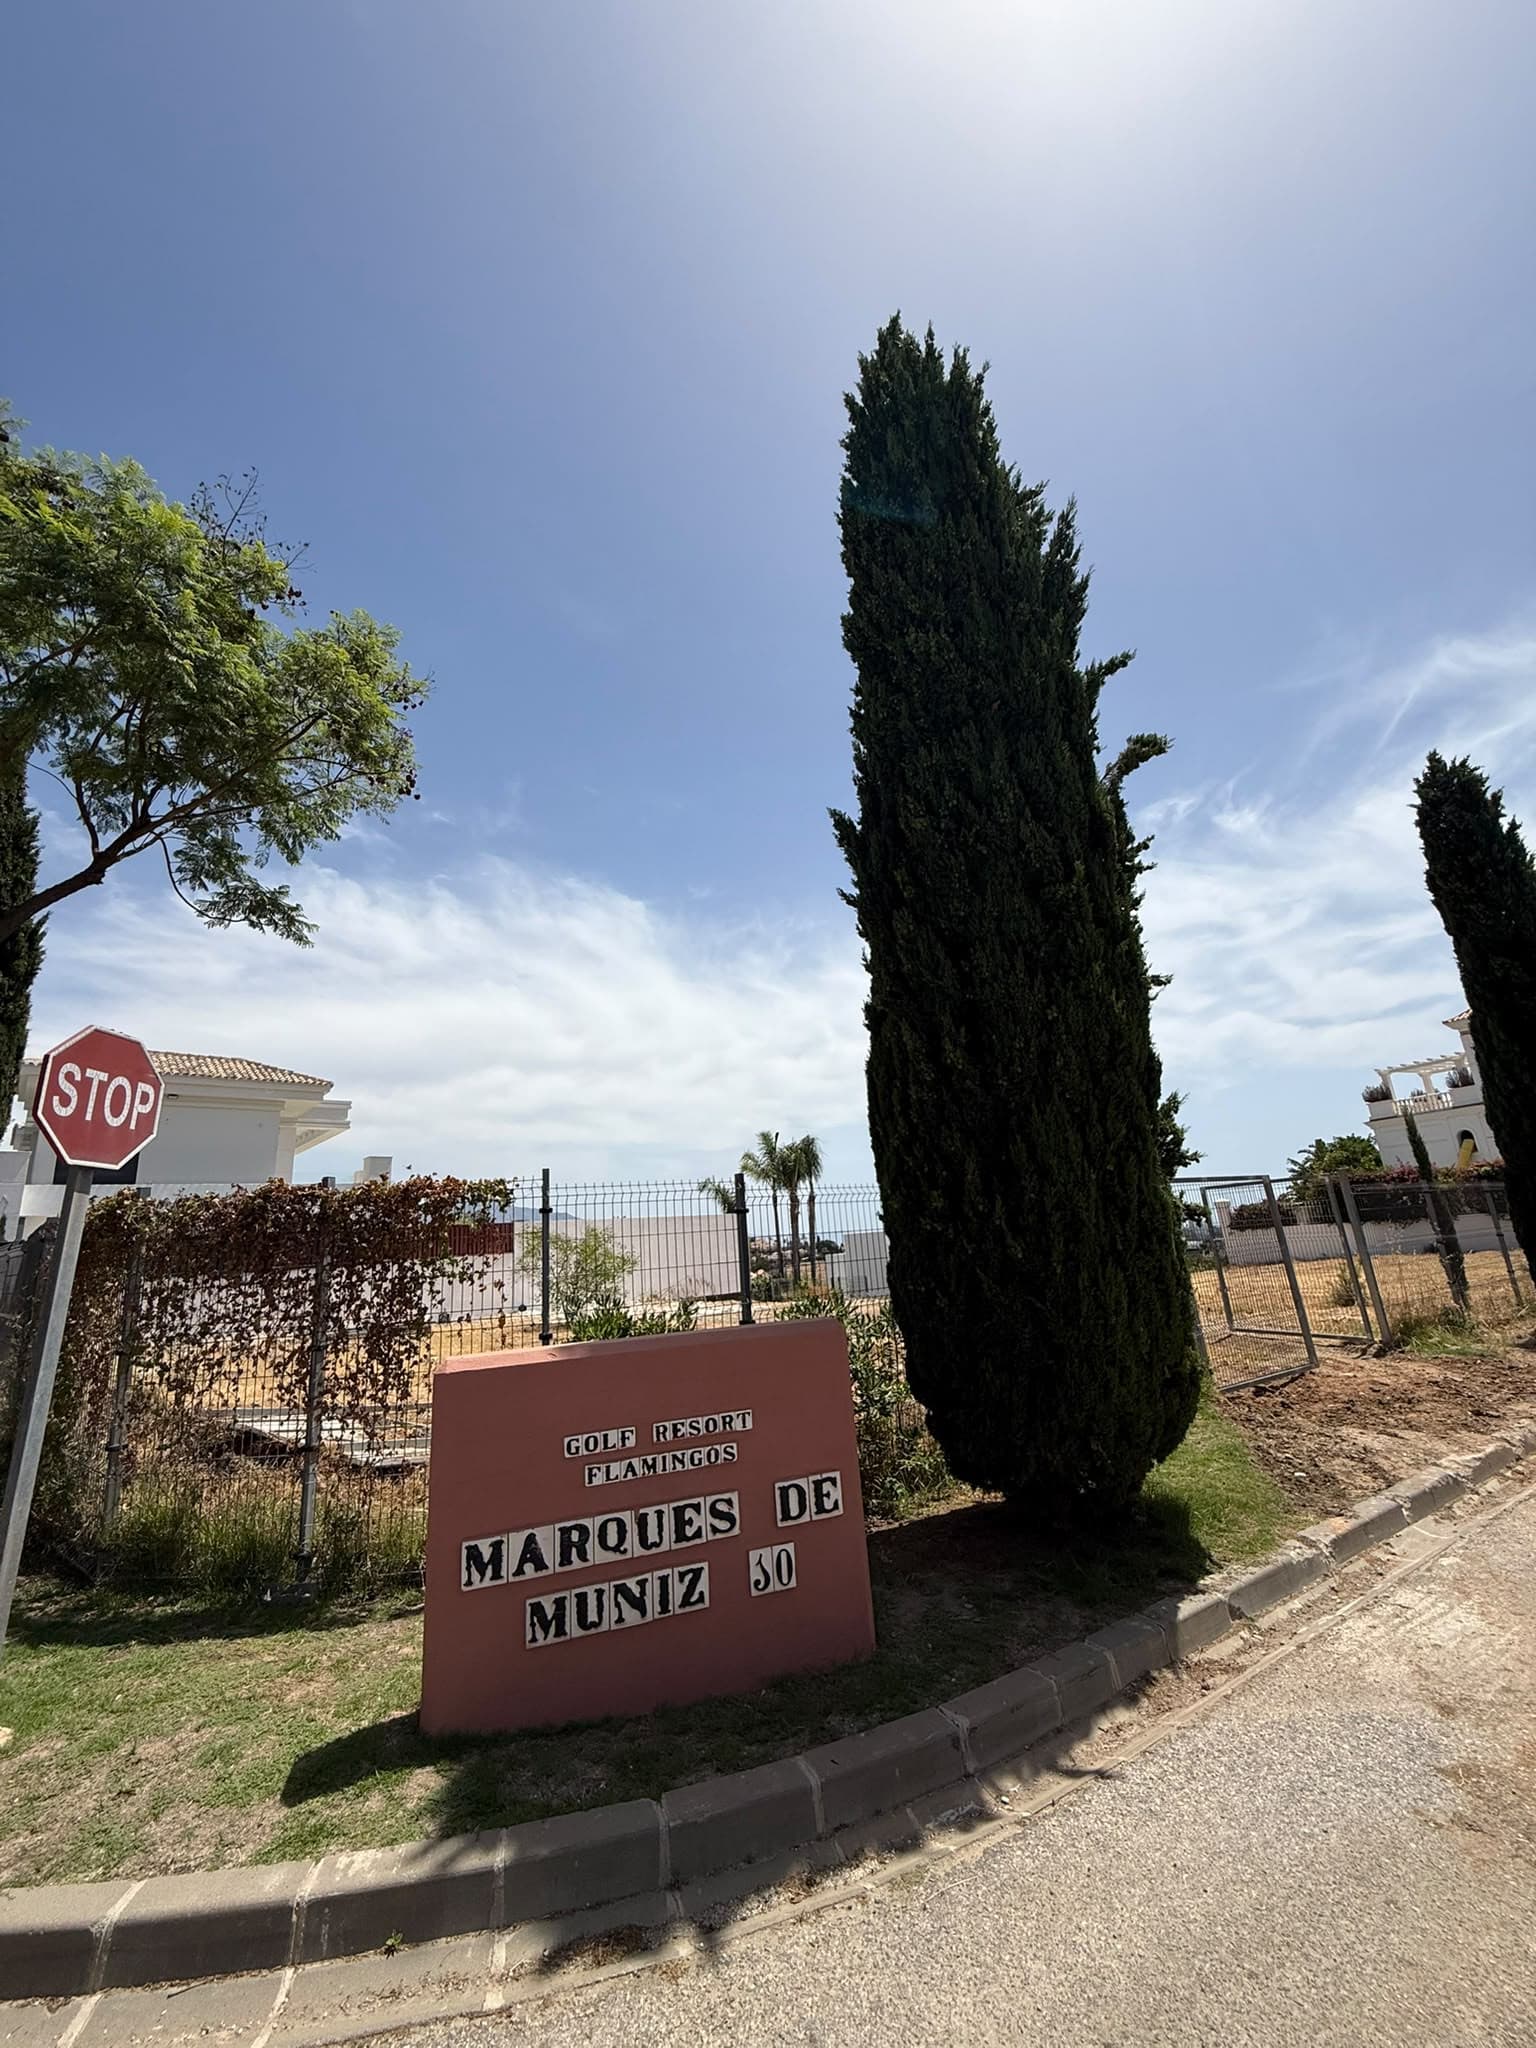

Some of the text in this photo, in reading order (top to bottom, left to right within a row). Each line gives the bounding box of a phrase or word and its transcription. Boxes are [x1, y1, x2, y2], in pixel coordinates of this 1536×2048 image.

[53, 1062, 155, 1130] STOP
[566, 1411, 751, 1456] GOLF RESORT
[587, 1445, 737, 1486] FLAMINGOS
[463, 1475, 839, 1588] MARQUES DE
[528, 1567, 706, 1645] MUNIZ
